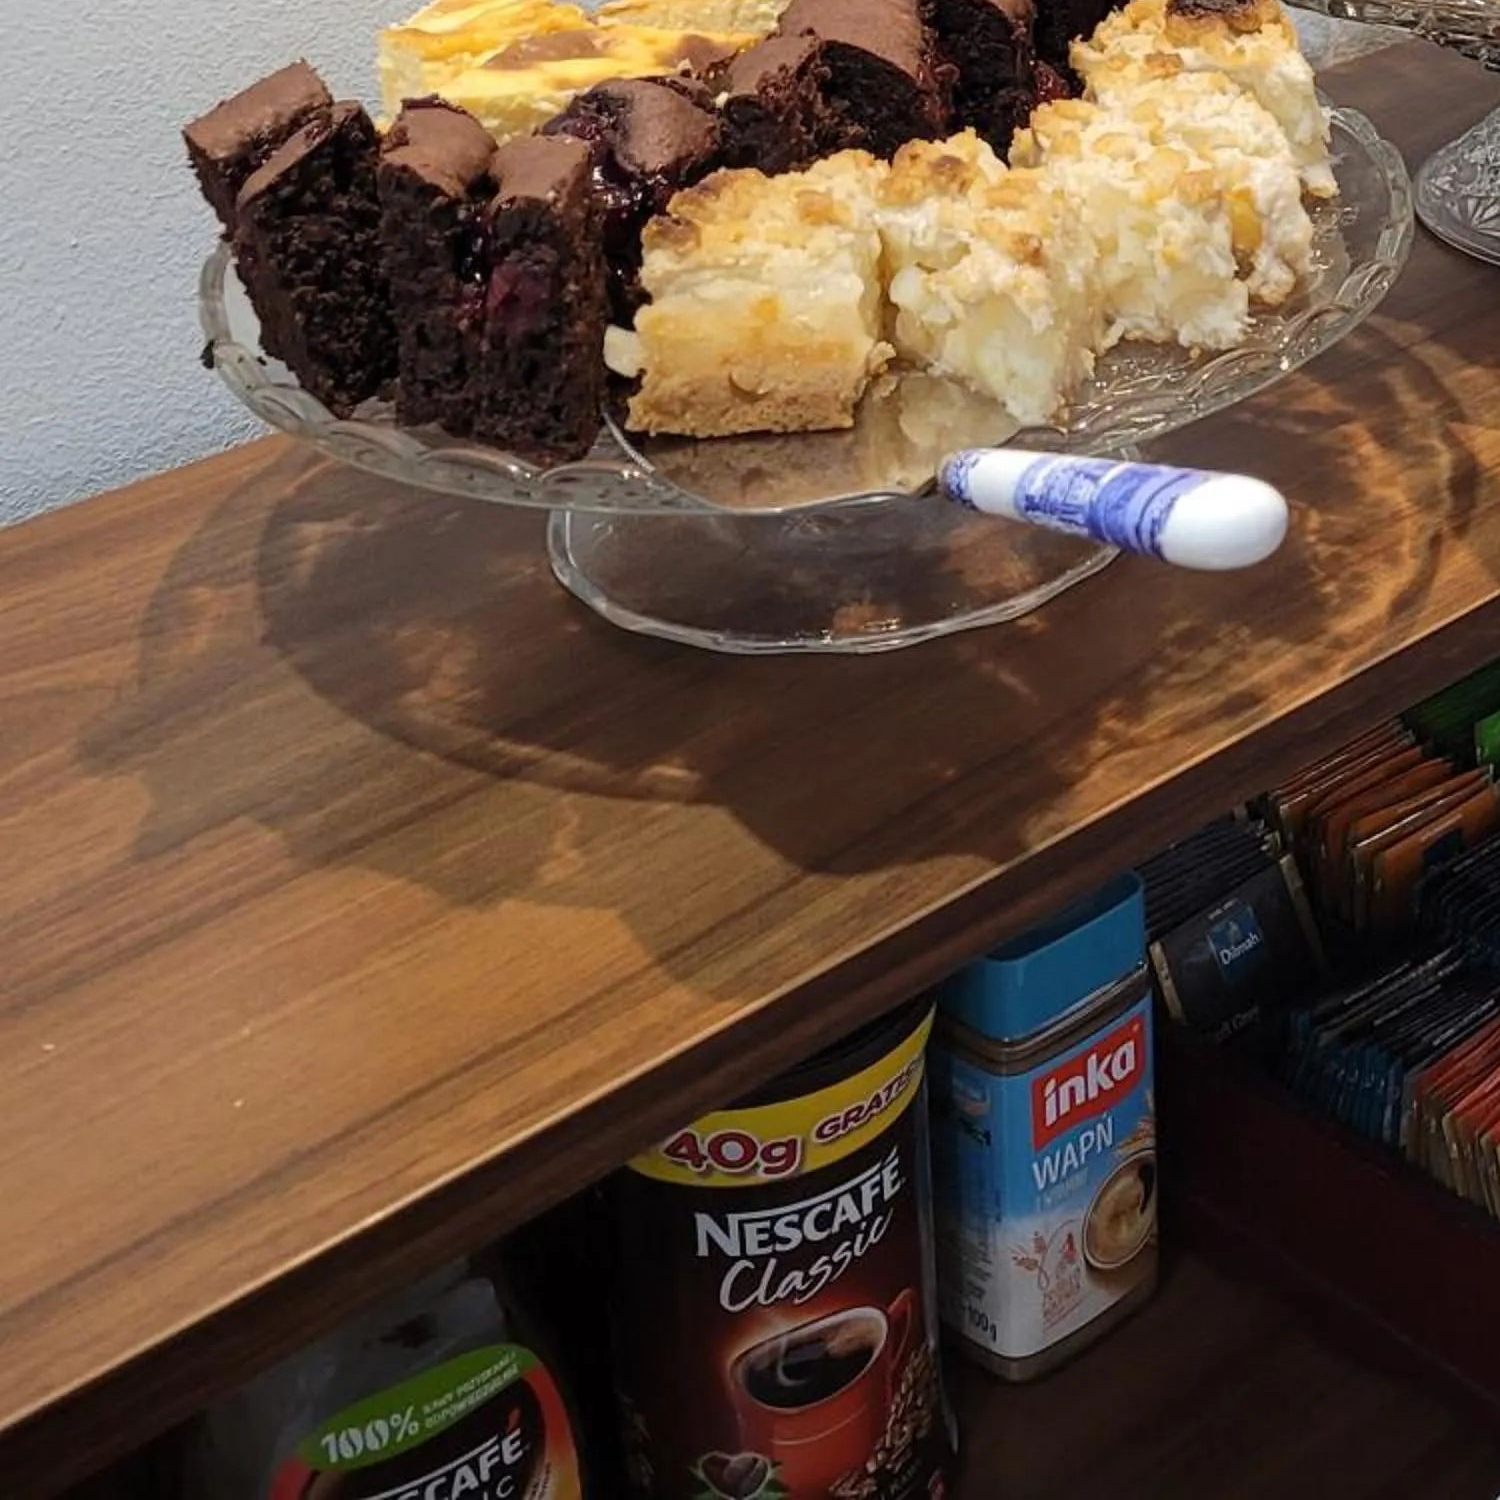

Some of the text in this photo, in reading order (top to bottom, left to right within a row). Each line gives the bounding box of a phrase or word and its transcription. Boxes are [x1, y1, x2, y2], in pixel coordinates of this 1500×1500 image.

[1043, 1039, 1136, 1129] inka
[661, 1129, 800, 1177] 40g
[1031, 1112, 1115, 1190] WAPŃ
[693, 1144, 902, 1257] NESCAFÉ
[719, 1206, 894, 1313] Classic
[320, 1402, 420, 1463] 100%
[362, 1406, 524, 1500] CAFÉ
